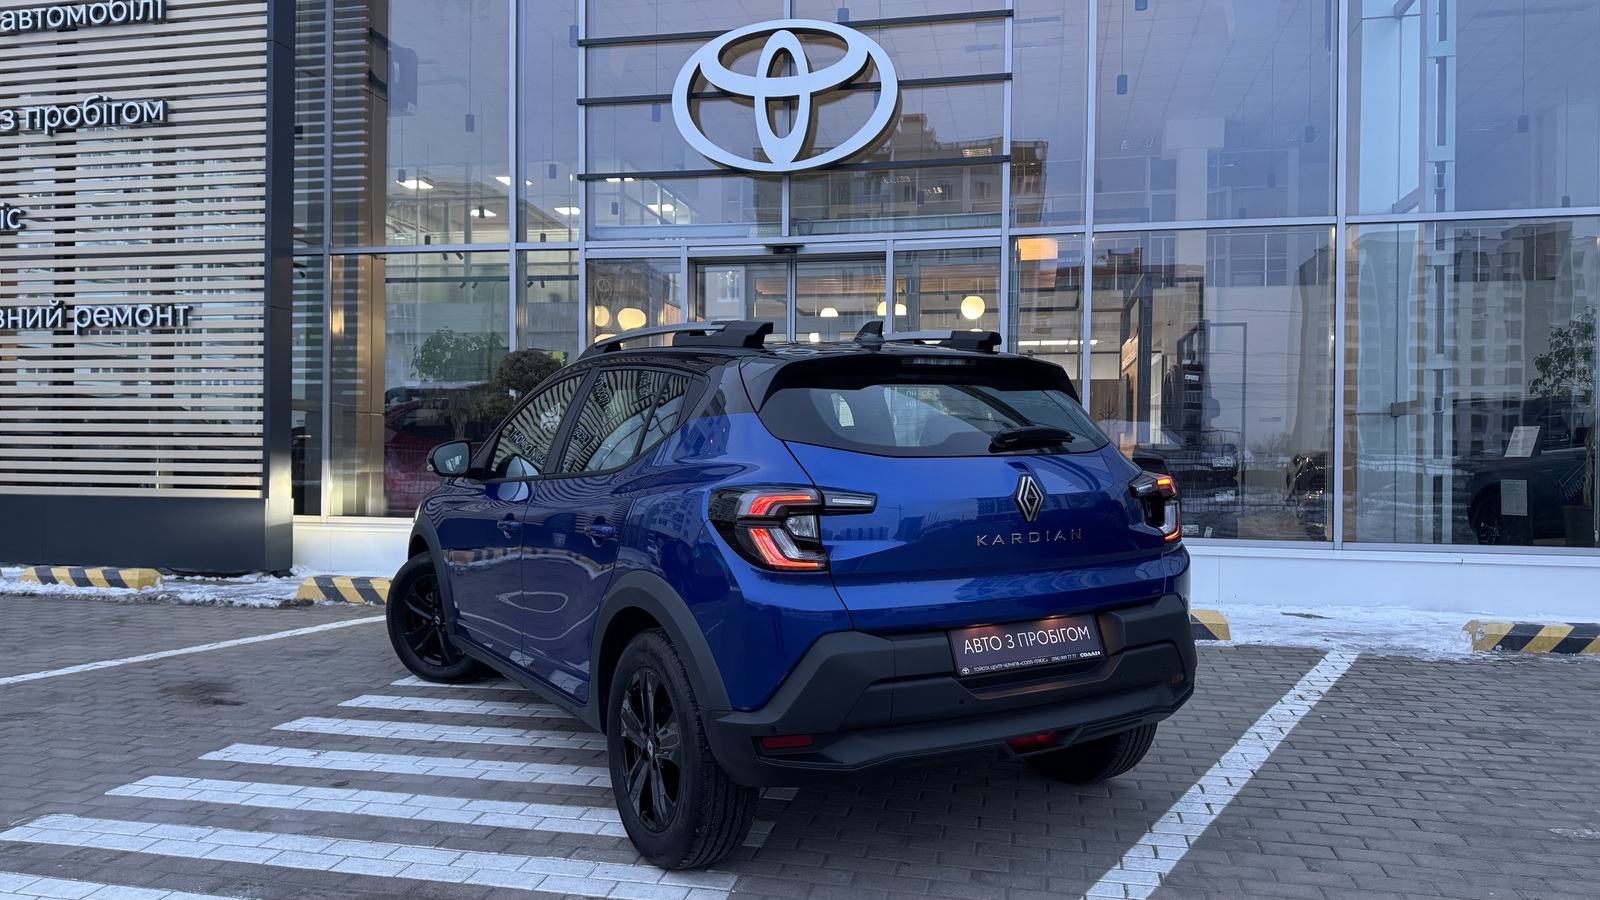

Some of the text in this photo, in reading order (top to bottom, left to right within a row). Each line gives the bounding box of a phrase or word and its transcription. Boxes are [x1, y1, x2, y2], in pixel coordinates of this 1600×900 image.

[1, 0, 163, 31] автомобілі
[1, 95, 164, 135] з пробігом
[74, 305, 189, 335] ремонт
[976, 528, 1082, 546] KARDIAN
[964, 635, 1002, 654] АВТО
[1017, 625, 1091, 648] ПРОБІГОМ
